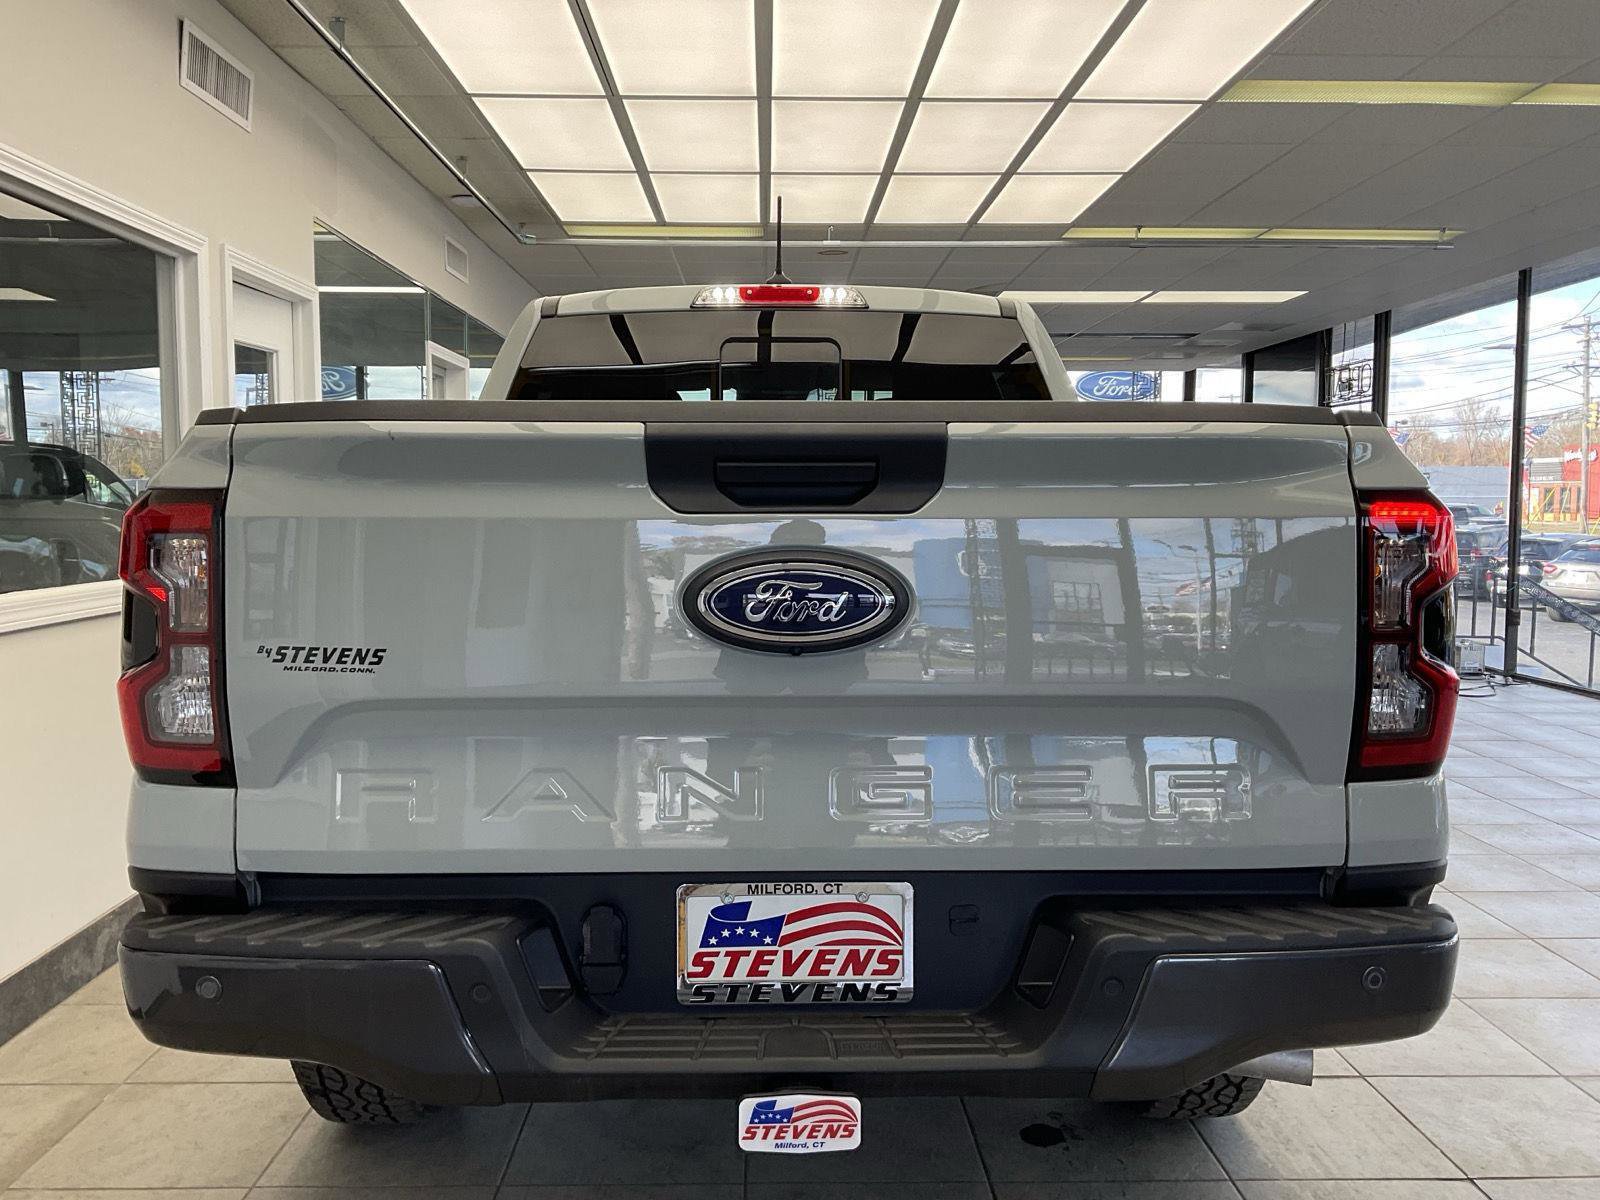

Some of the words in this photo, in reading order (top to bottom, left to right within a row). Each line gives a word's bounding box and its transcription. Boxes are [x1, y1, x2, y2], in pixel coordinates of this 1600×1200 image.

[745, 580, 849, 622] Ford
[257, 645, 272, 658] By
[272, 646, 387, 666] STEVENS
[335, 764, 1253, 823] RANGER
[747, 883, 818, 895] MILFORD,
[823, 883, 843, 894] CT
[687, 950, 903, 978] STEVENS
[689, 983, 902, 1003] STEVENS
[741, 1124, 858, 1140] STEVENS
